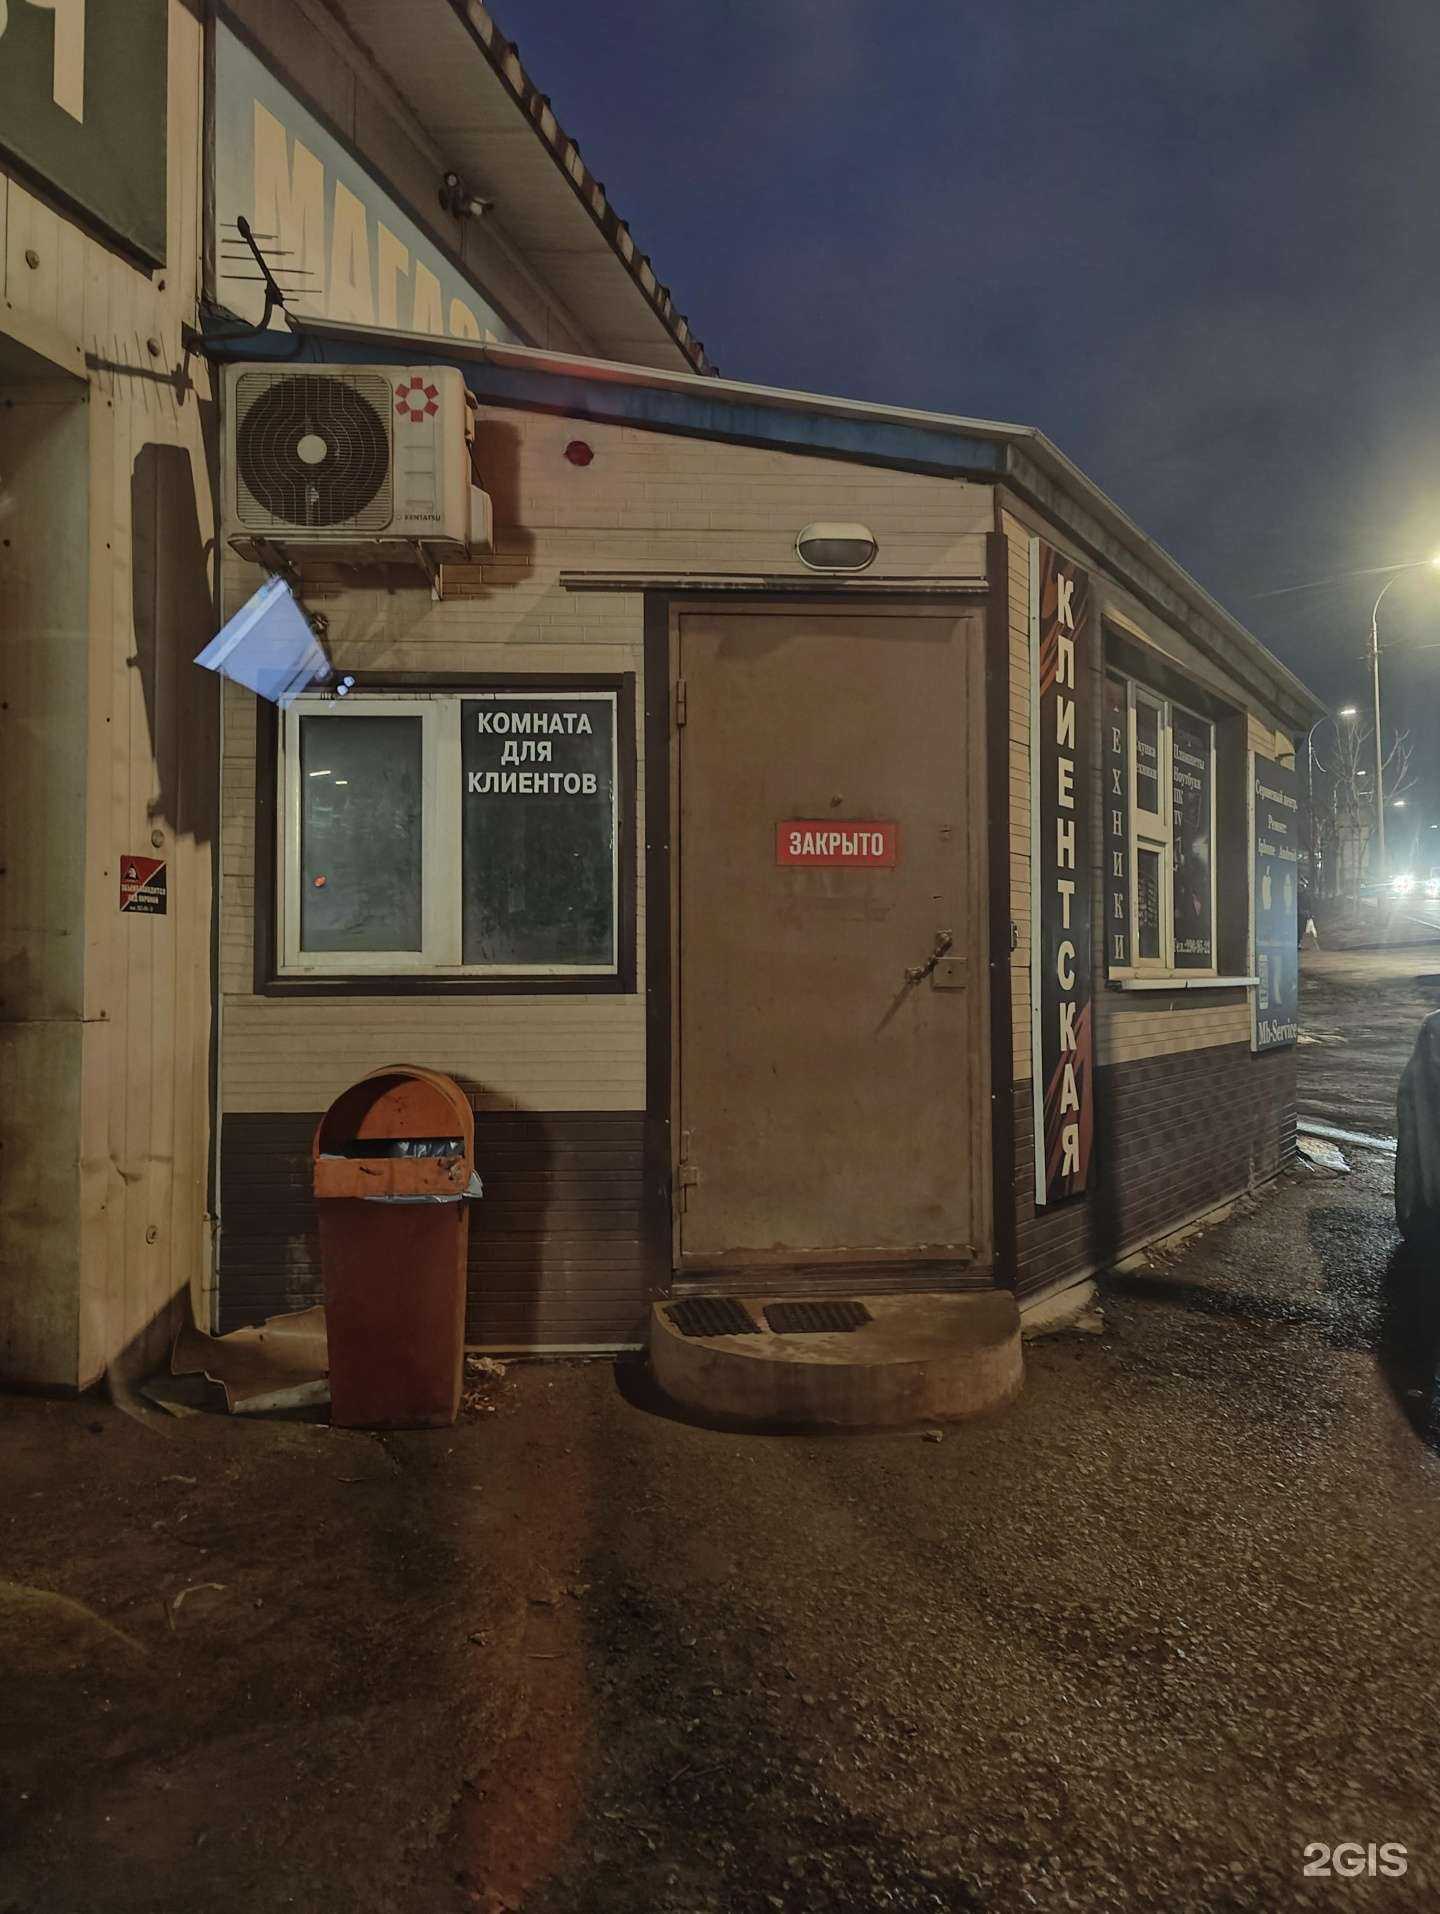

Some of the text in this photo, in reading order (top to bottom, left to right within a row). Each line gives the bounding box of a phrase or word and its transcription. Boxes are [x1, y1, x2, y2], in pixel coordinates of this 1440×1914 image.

[478, 712, 593, 734] КОМНАТА
[501, 740, 552, 766] ДЛЯ
[468, 771, 598, 794] КЛИЕНТОВ
[789, 832, 884, 856] ЗАКРЫТО
[1111, 704, 1126, 963] ЕХНИКИ
[1055, 573, 1083, 1178] КЛИЕНТСКАЯ
